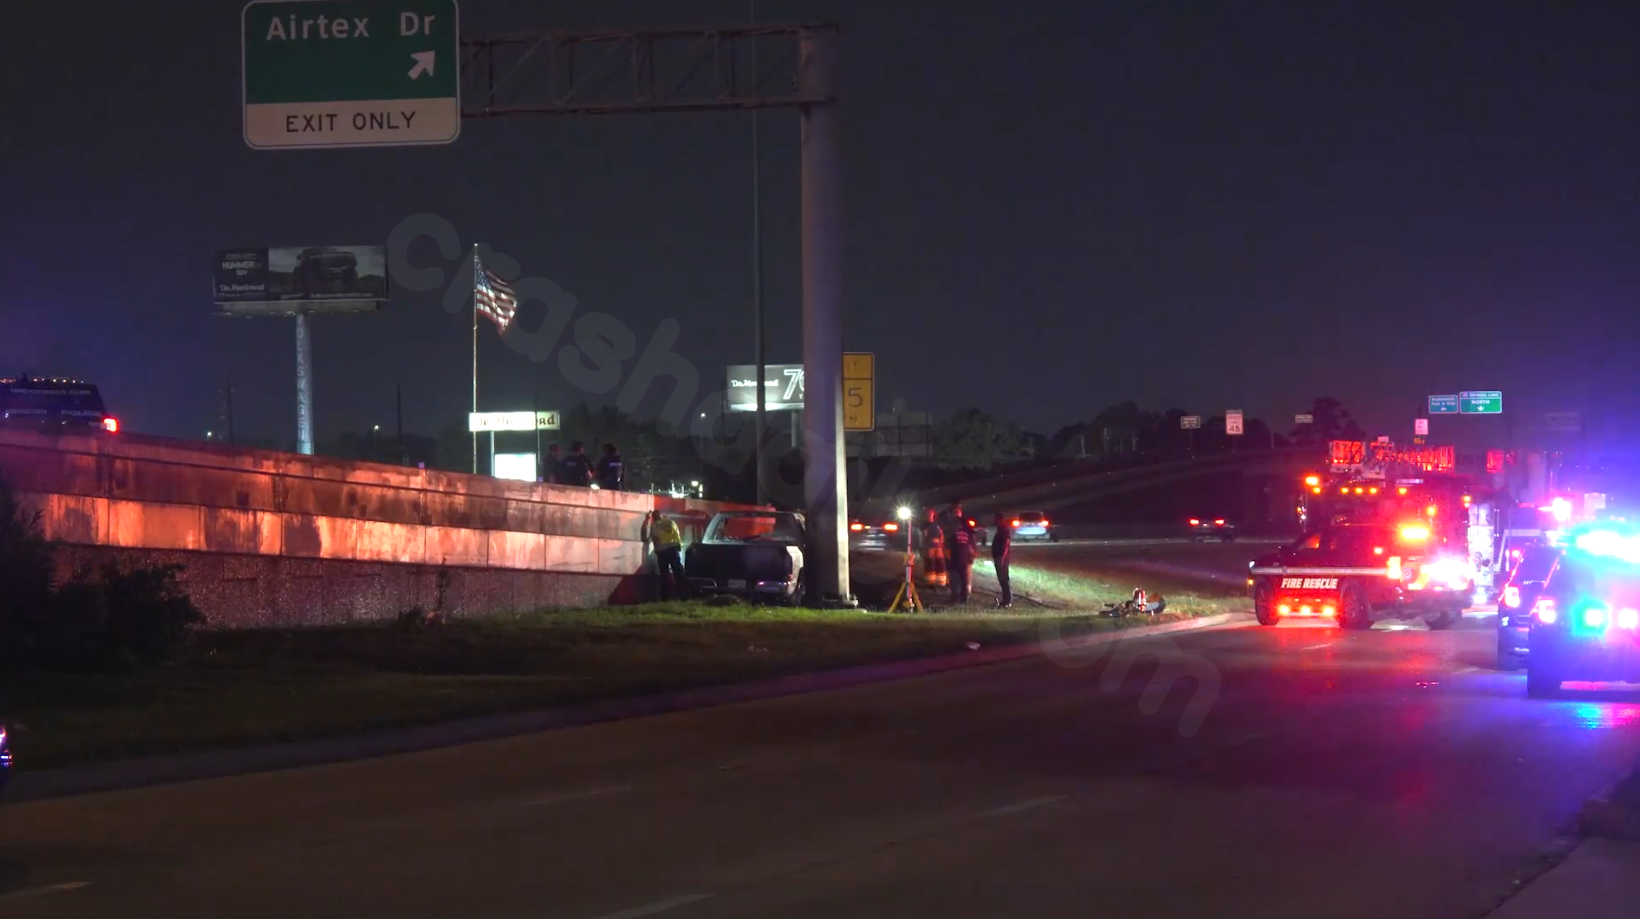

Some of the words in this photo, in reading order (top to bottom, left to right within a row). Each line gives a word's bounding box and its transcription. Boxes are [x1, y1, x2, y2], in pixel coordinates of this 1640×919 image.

[266, 14, 370, 41] Airtex
[400, 12, 435, 36] Dr
[286, 114, 338, 132] EXIT
[352, 111, 416, 130] ONLY
[222, 261, 254, 270] HUMMER
[1281, 578, 1303, 589] FIRE
[1303, 578, 1339, 589] RESCUE
